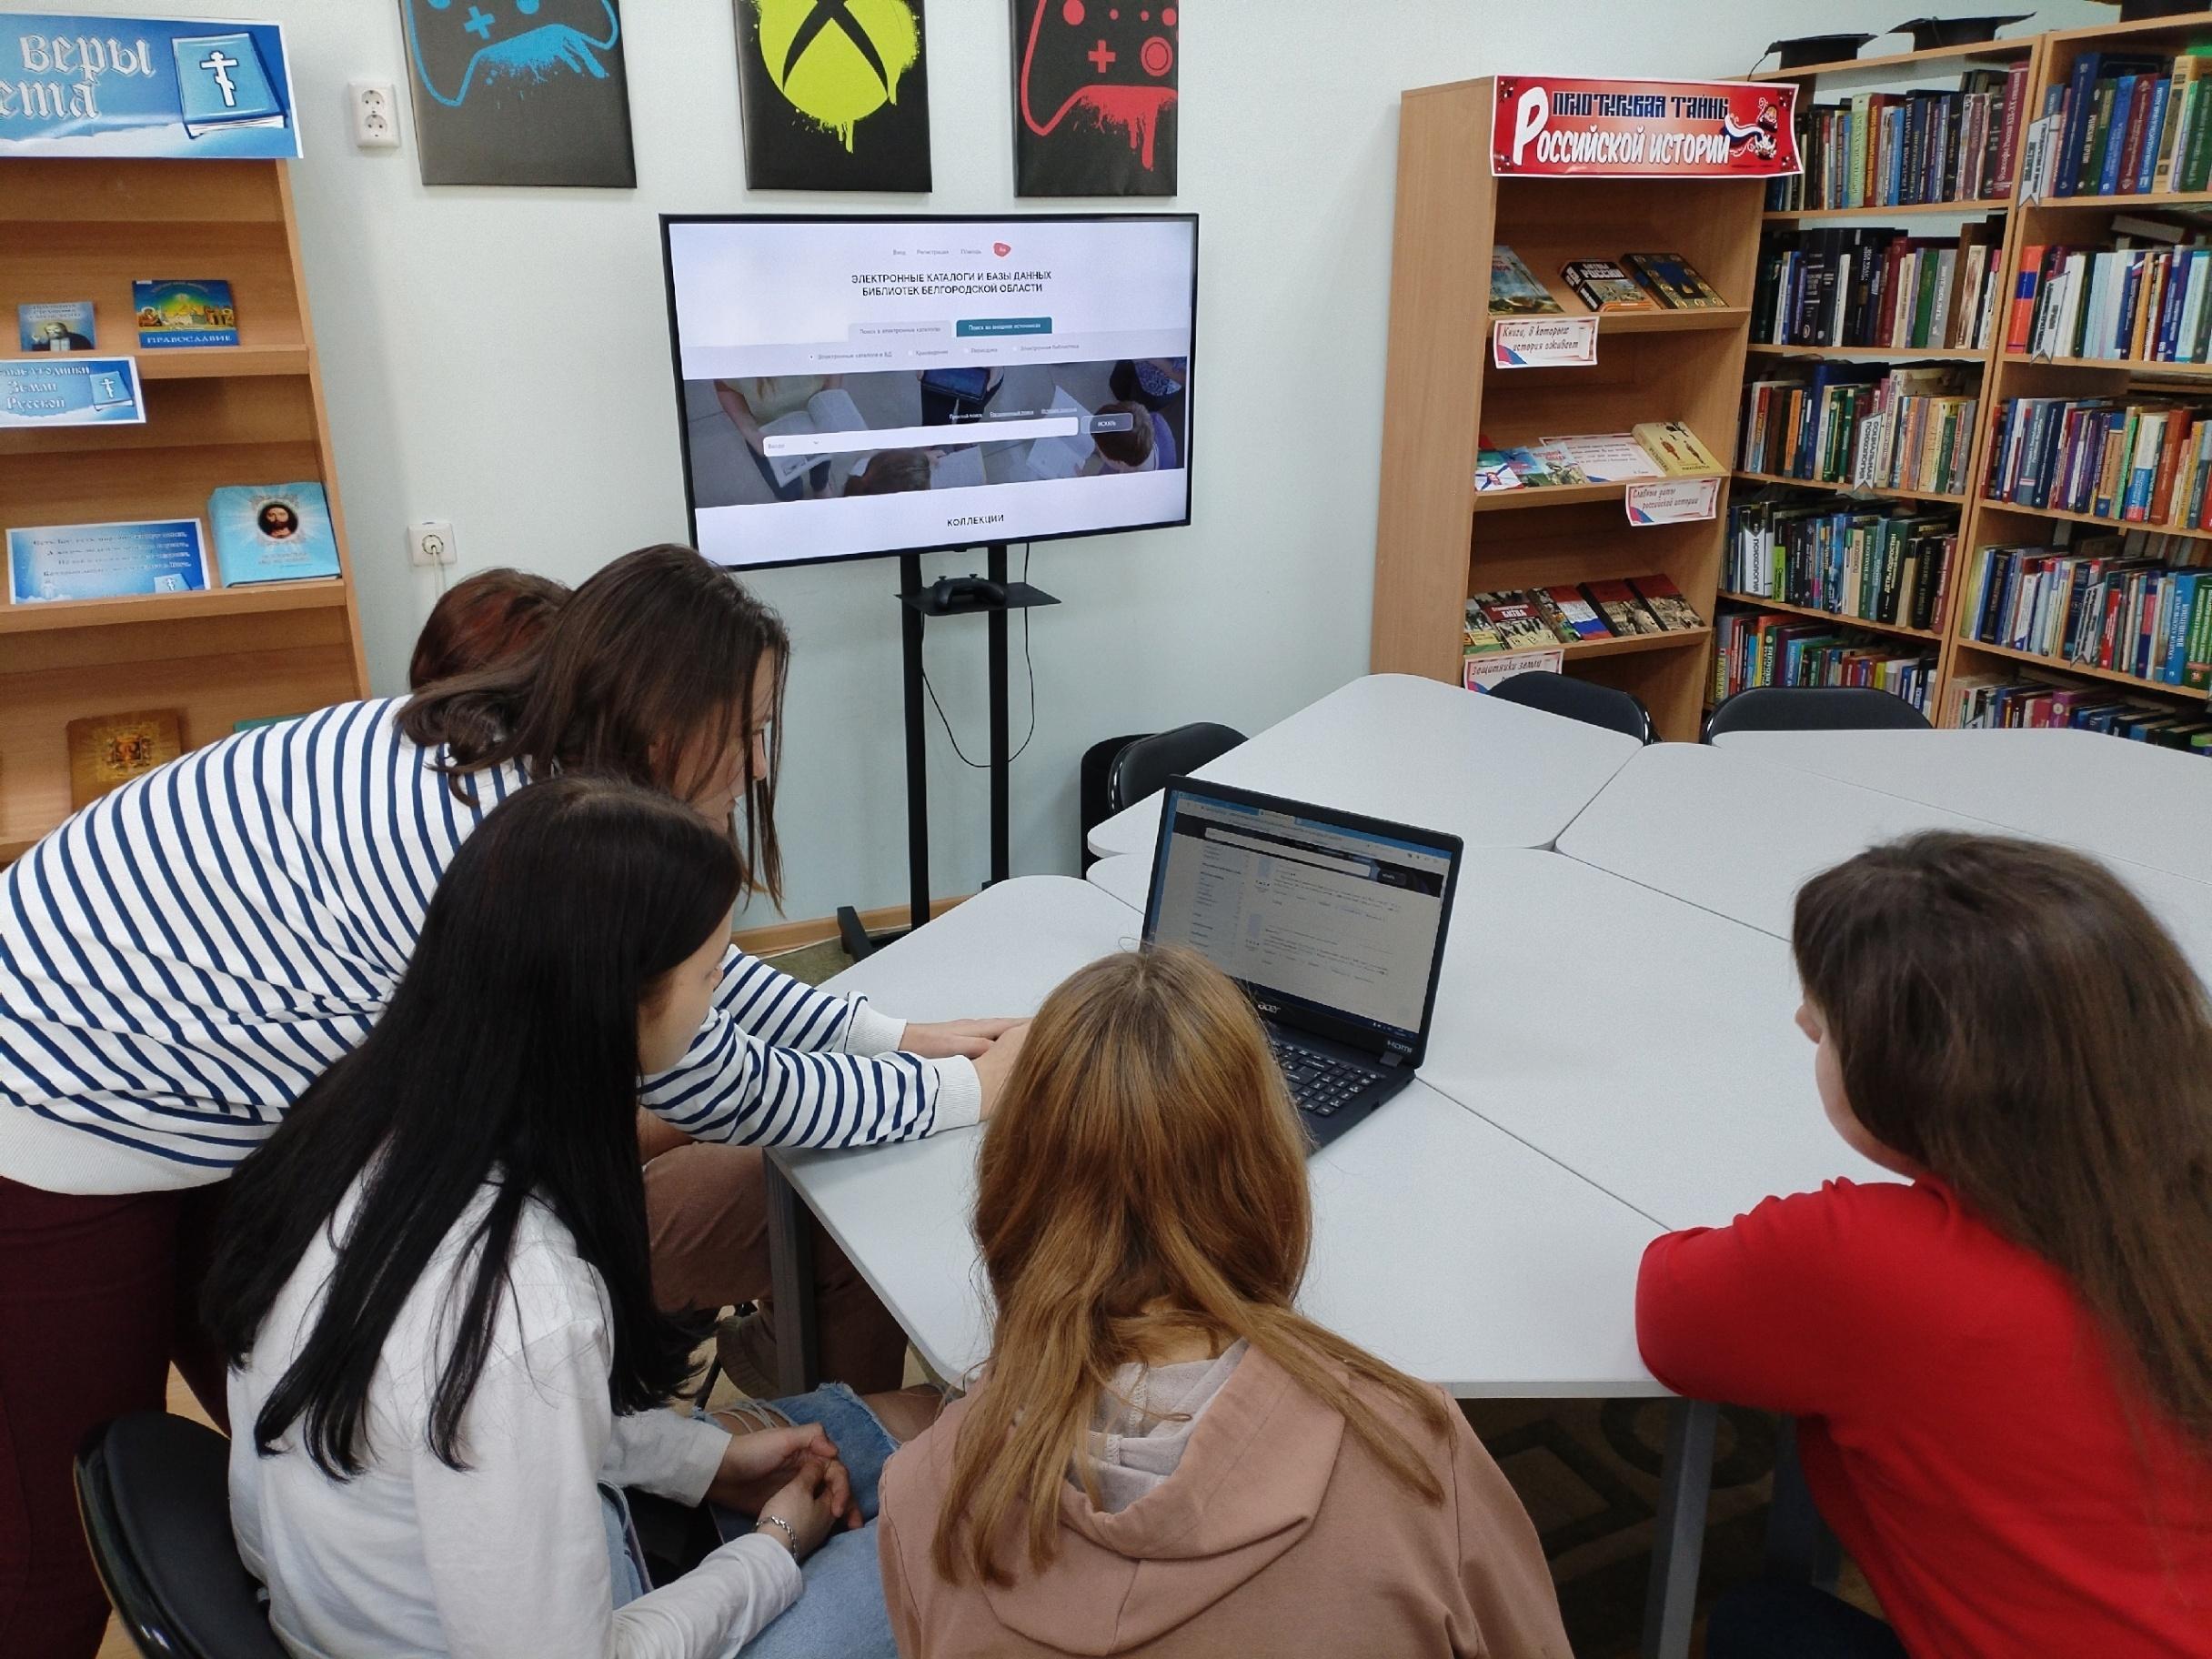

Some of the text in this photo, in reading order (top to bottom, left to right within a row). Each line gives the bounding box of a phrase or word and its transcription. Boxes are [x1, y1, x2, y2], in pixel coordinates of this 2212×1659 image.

[18, 32, 156, 84] веры
[1649, 132, 1730, 165] ИСТОРИИ
[851, 271, 1051, 284] ЭЛЕКТРОННЫЕ КАТАЛОГИ И БАЗЫ ДАННЫХ
[862, 283, 1042, 297] БИБЛИОТЕК БЕЛГОРОДСКОЙ ОБЛАСТИ
[146, 335, 234, 346] ПРАВОСЛАВИЕ
[1503, 327, 1526, 339] Книги,
[6, 396, 65, 412] Русской
[1859, 420, 1871, 478] ПСИХОЛОГИЯ
[1865, 420, 1878, 480] СОЦИАЛЬНАЯ
[947, 514, 1004, 528] КОЛЛЕКЦИИ
[1472, 659, 1515, 675] Защитники
[1258, 1001, 1281, 1014] acer
